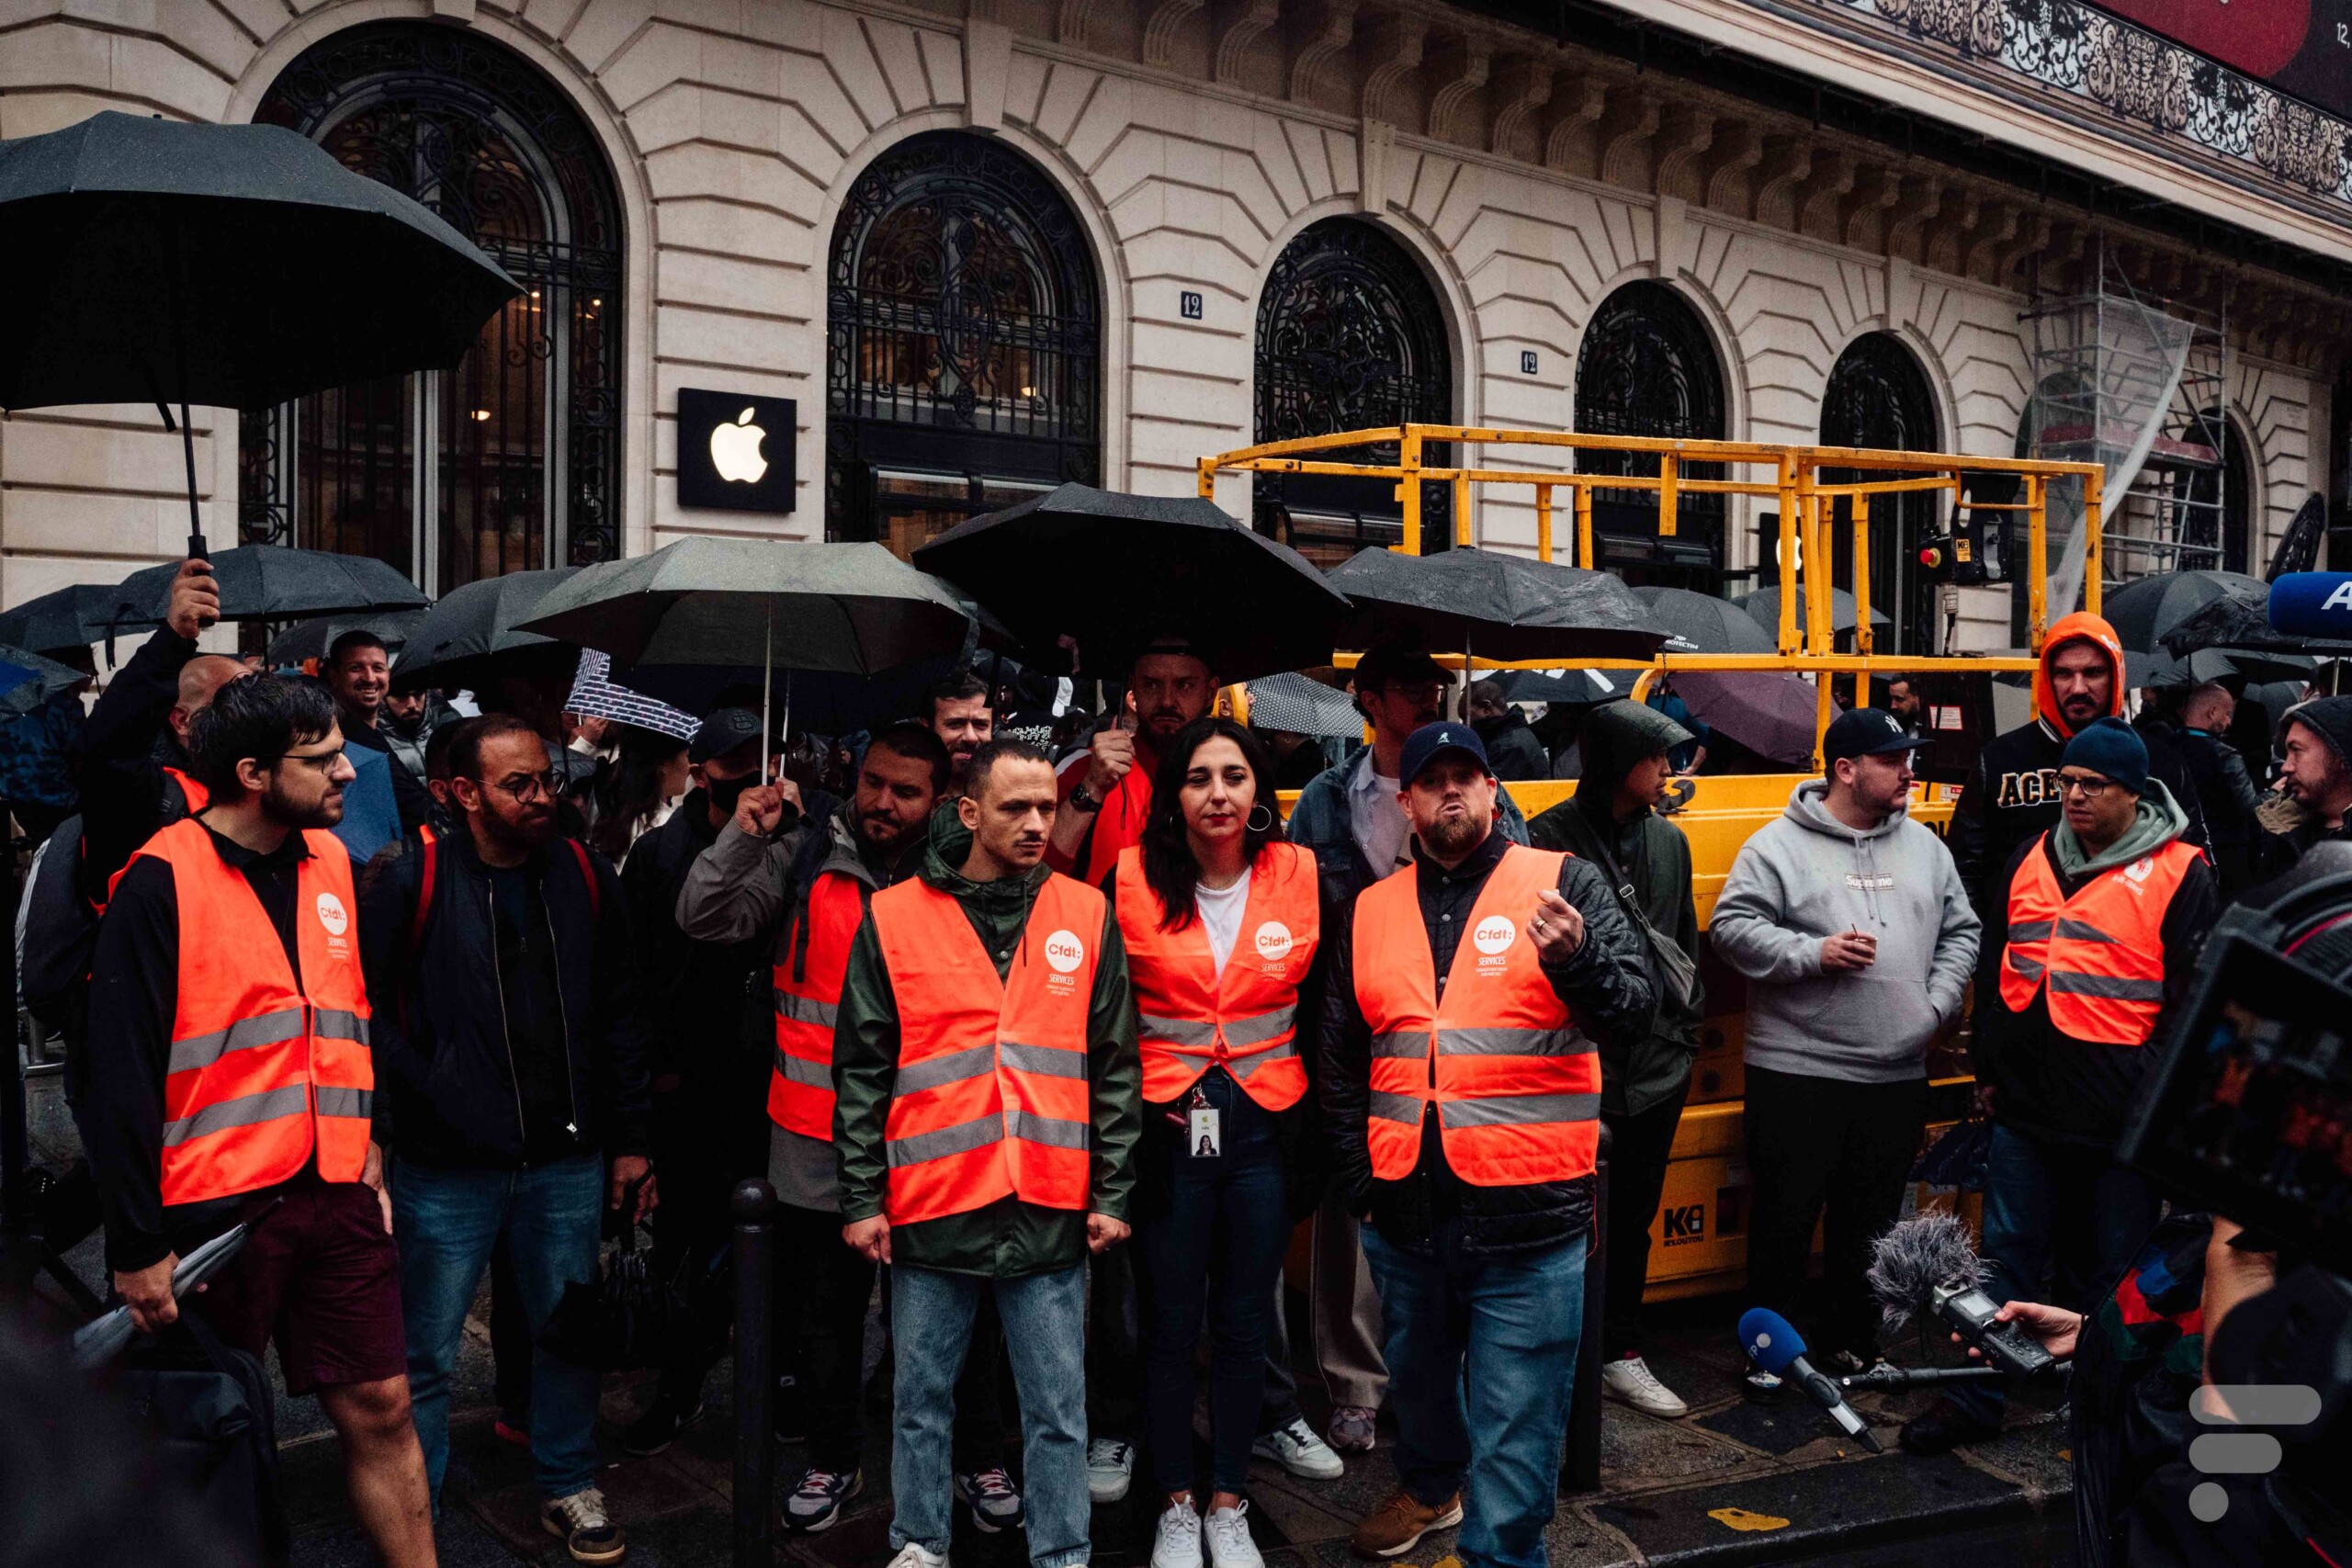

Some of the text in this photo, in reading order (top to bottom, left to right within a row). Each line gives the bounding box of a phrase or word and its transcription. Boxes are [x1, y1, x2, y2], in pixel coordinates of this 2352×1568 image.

[2336, 22, 2350, 49] 12,
[1184, 295, 1200, 316] 12
[1523, 354, 1536, 372] 12
[2321, 581, 2352, 611] A
[1477, 956, 1506, 965] SERVICES
[1049, 974, 1075, 985] SERVICES
